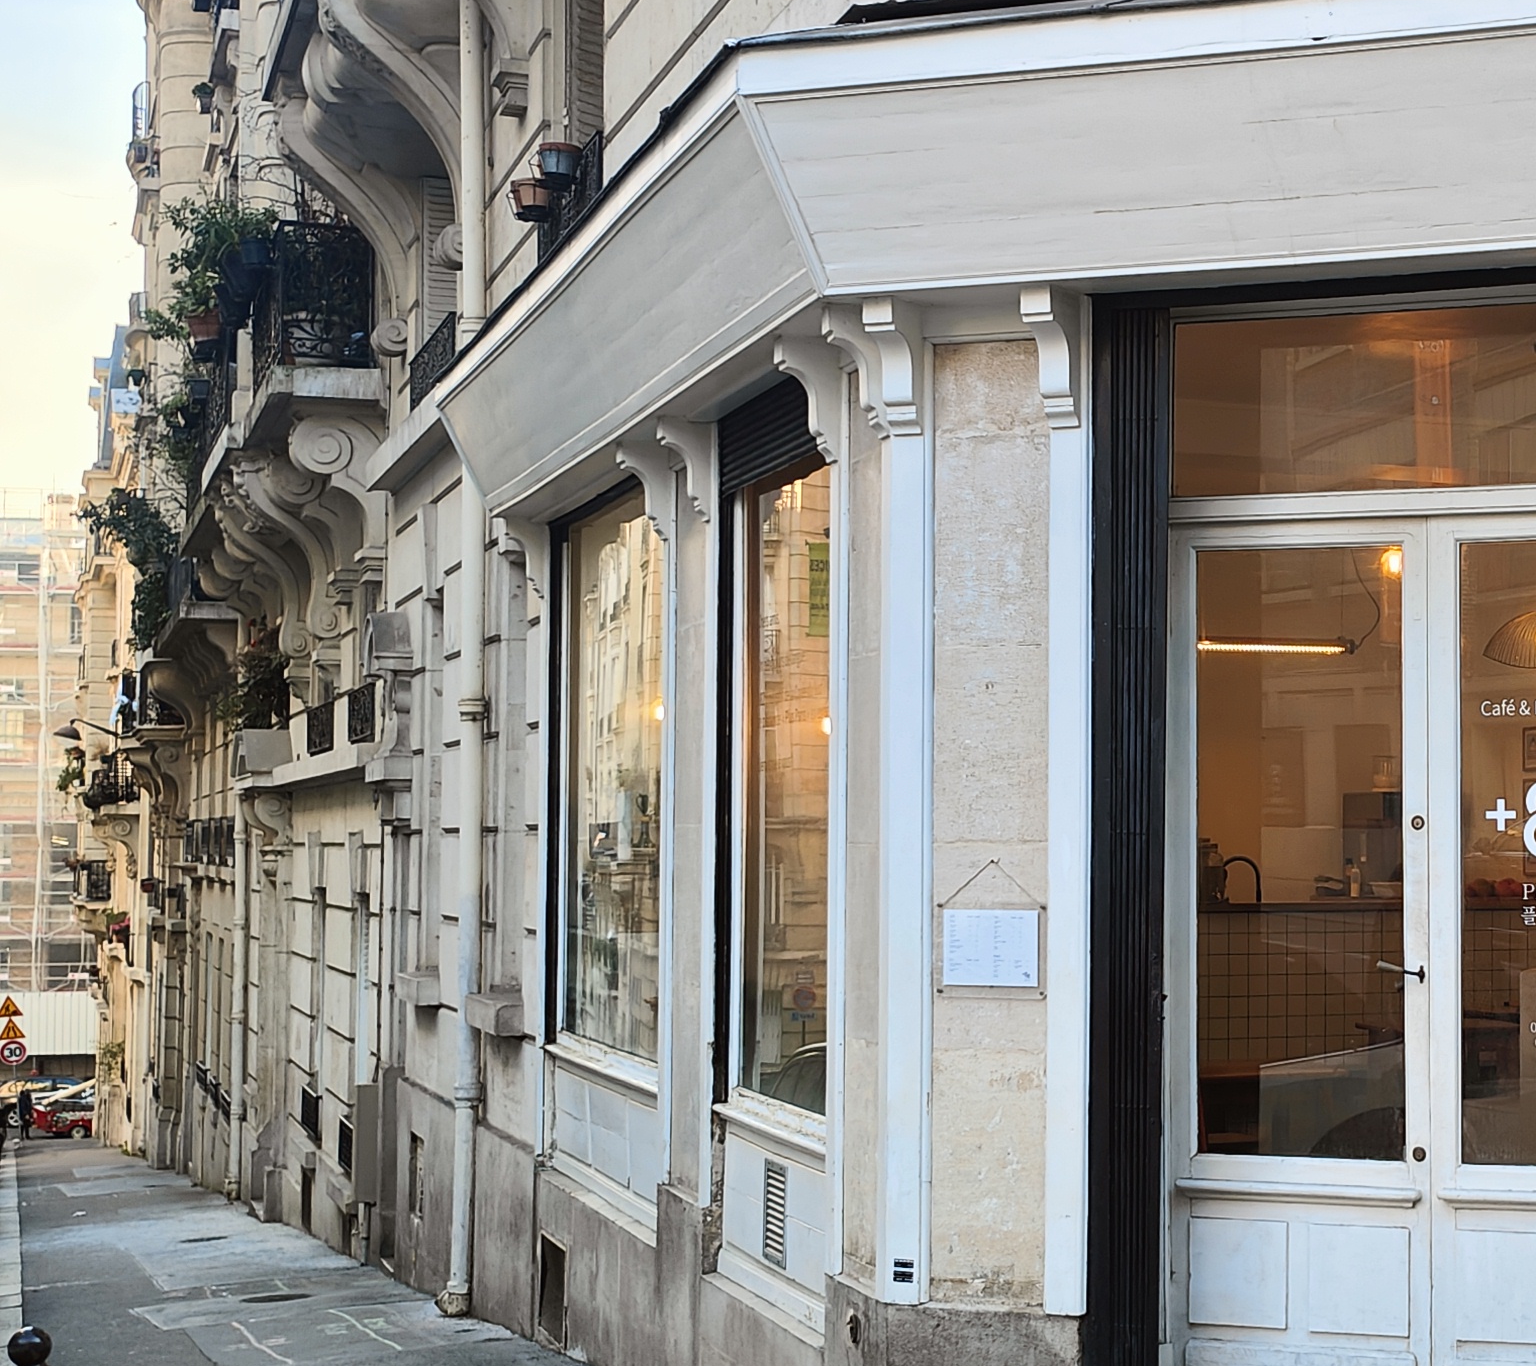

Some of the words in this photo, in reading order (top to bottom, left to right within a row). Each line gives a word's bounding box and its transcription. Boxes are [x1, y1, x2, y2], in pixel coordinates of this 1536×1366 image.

[1480, 699, 1516, 716] Café
[1519, 701, 1531, 716] &
[5, 1046, 22, 1059] 30
